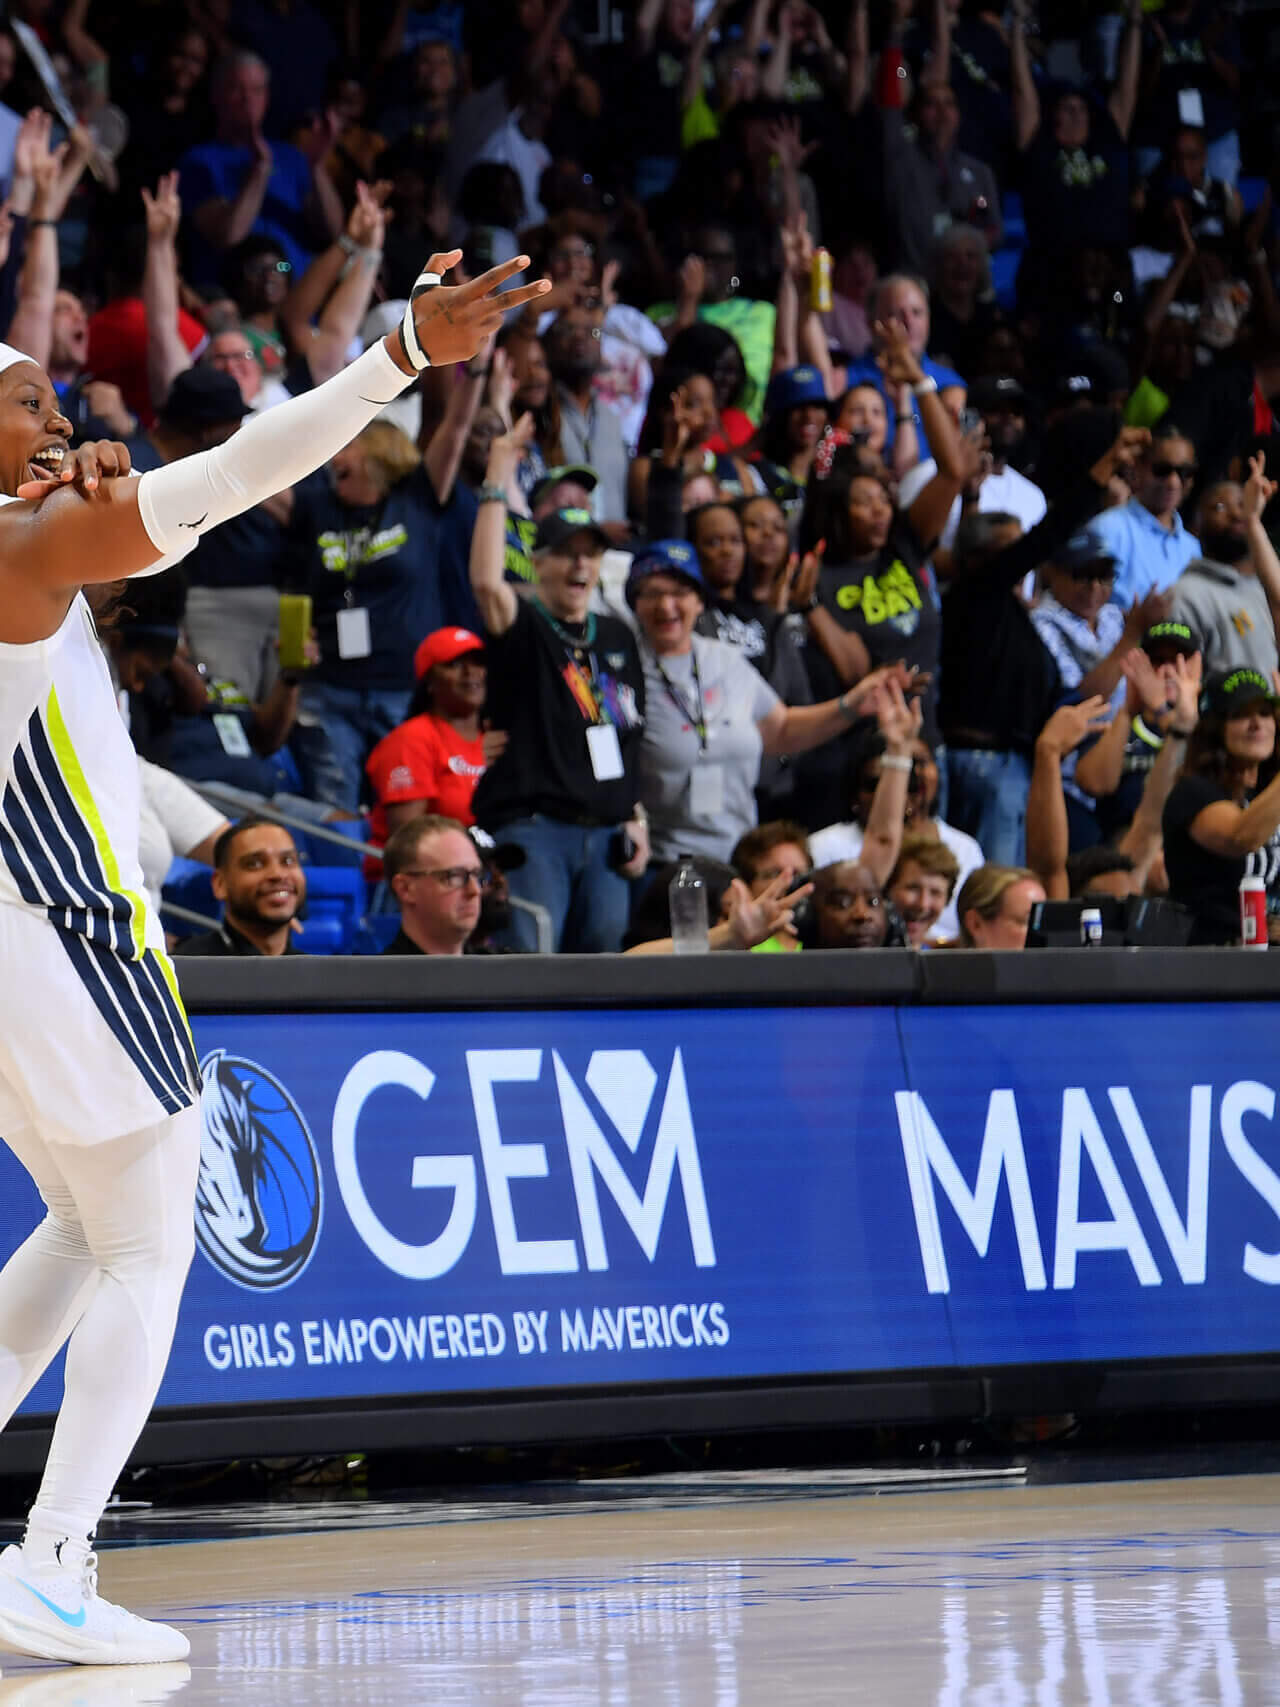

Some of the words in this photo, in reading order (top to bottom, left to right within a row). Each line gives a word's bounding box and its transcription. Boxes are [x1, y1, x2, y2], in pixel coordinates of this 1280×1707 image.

[332, 1046, 717, 1281] GEM
[203, 1322, 295, 1371] GIRLS
[302, 1311, 506, 1366] EMPOWERED
[513, 1309, 549, 1355] BY
[560, 1303, 730, 1354] MAVERICKS
